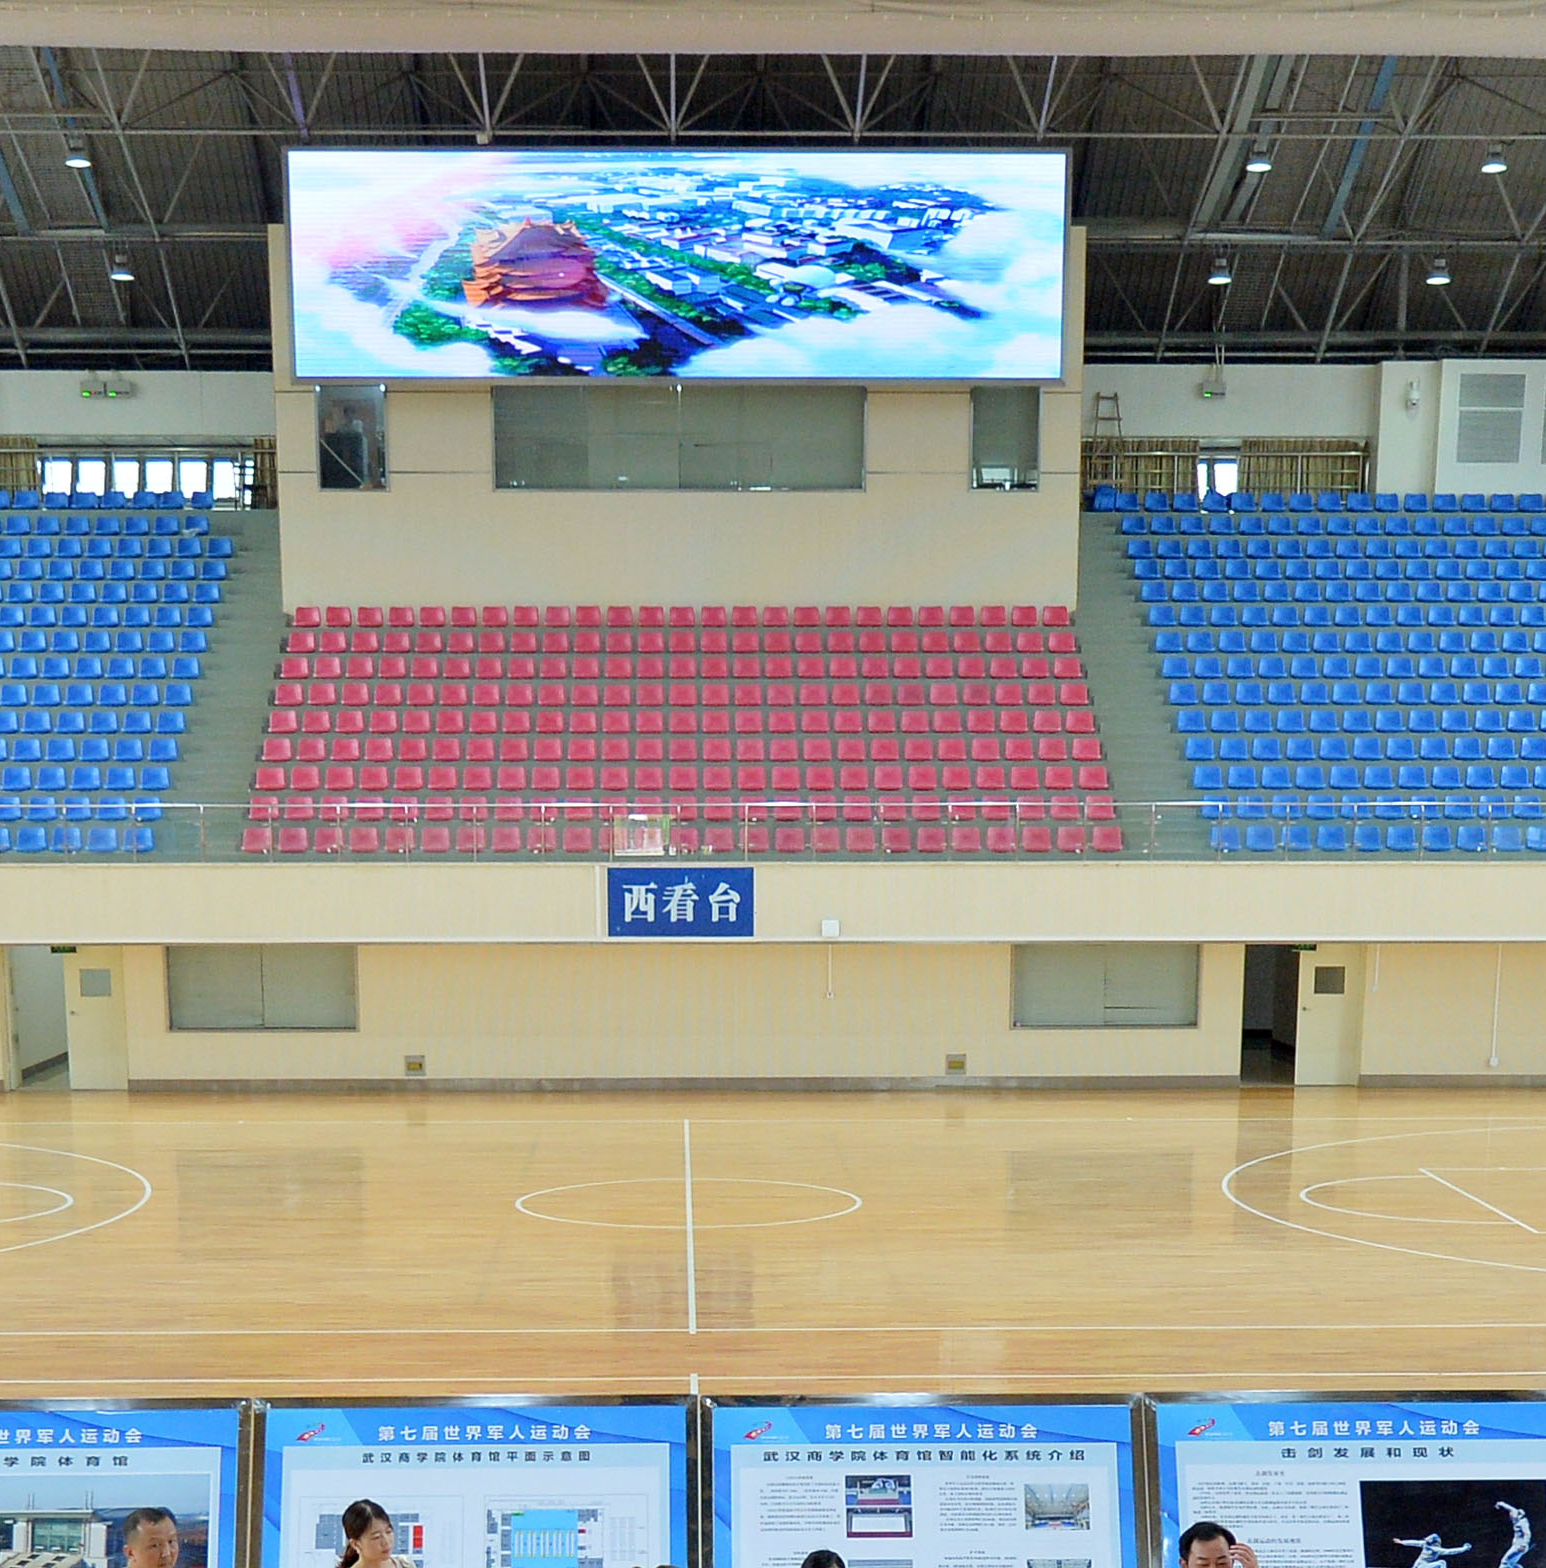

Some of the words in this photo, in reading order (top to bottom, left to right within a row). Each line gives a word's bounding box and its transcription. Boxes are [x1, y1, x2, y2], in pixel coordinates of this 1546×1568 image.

[622, 881, 741, 923] 西看台
[377, 1424, 593, 1442] 第七届世界军人运动会
[824, 1423, 1039, 1441] 第七届世界军人运动会
[1268, 1418, 1481, 1437] 第七届世界军人运动会
[361, 1450, 593, 1465] 武汉商学院体育馆平面示意图
[762, 1448, 1087, 1463] 武汉商学院体育馆智能化系统介绍
[1280, 1446, 1456, 1460] 击剑发展和现状
